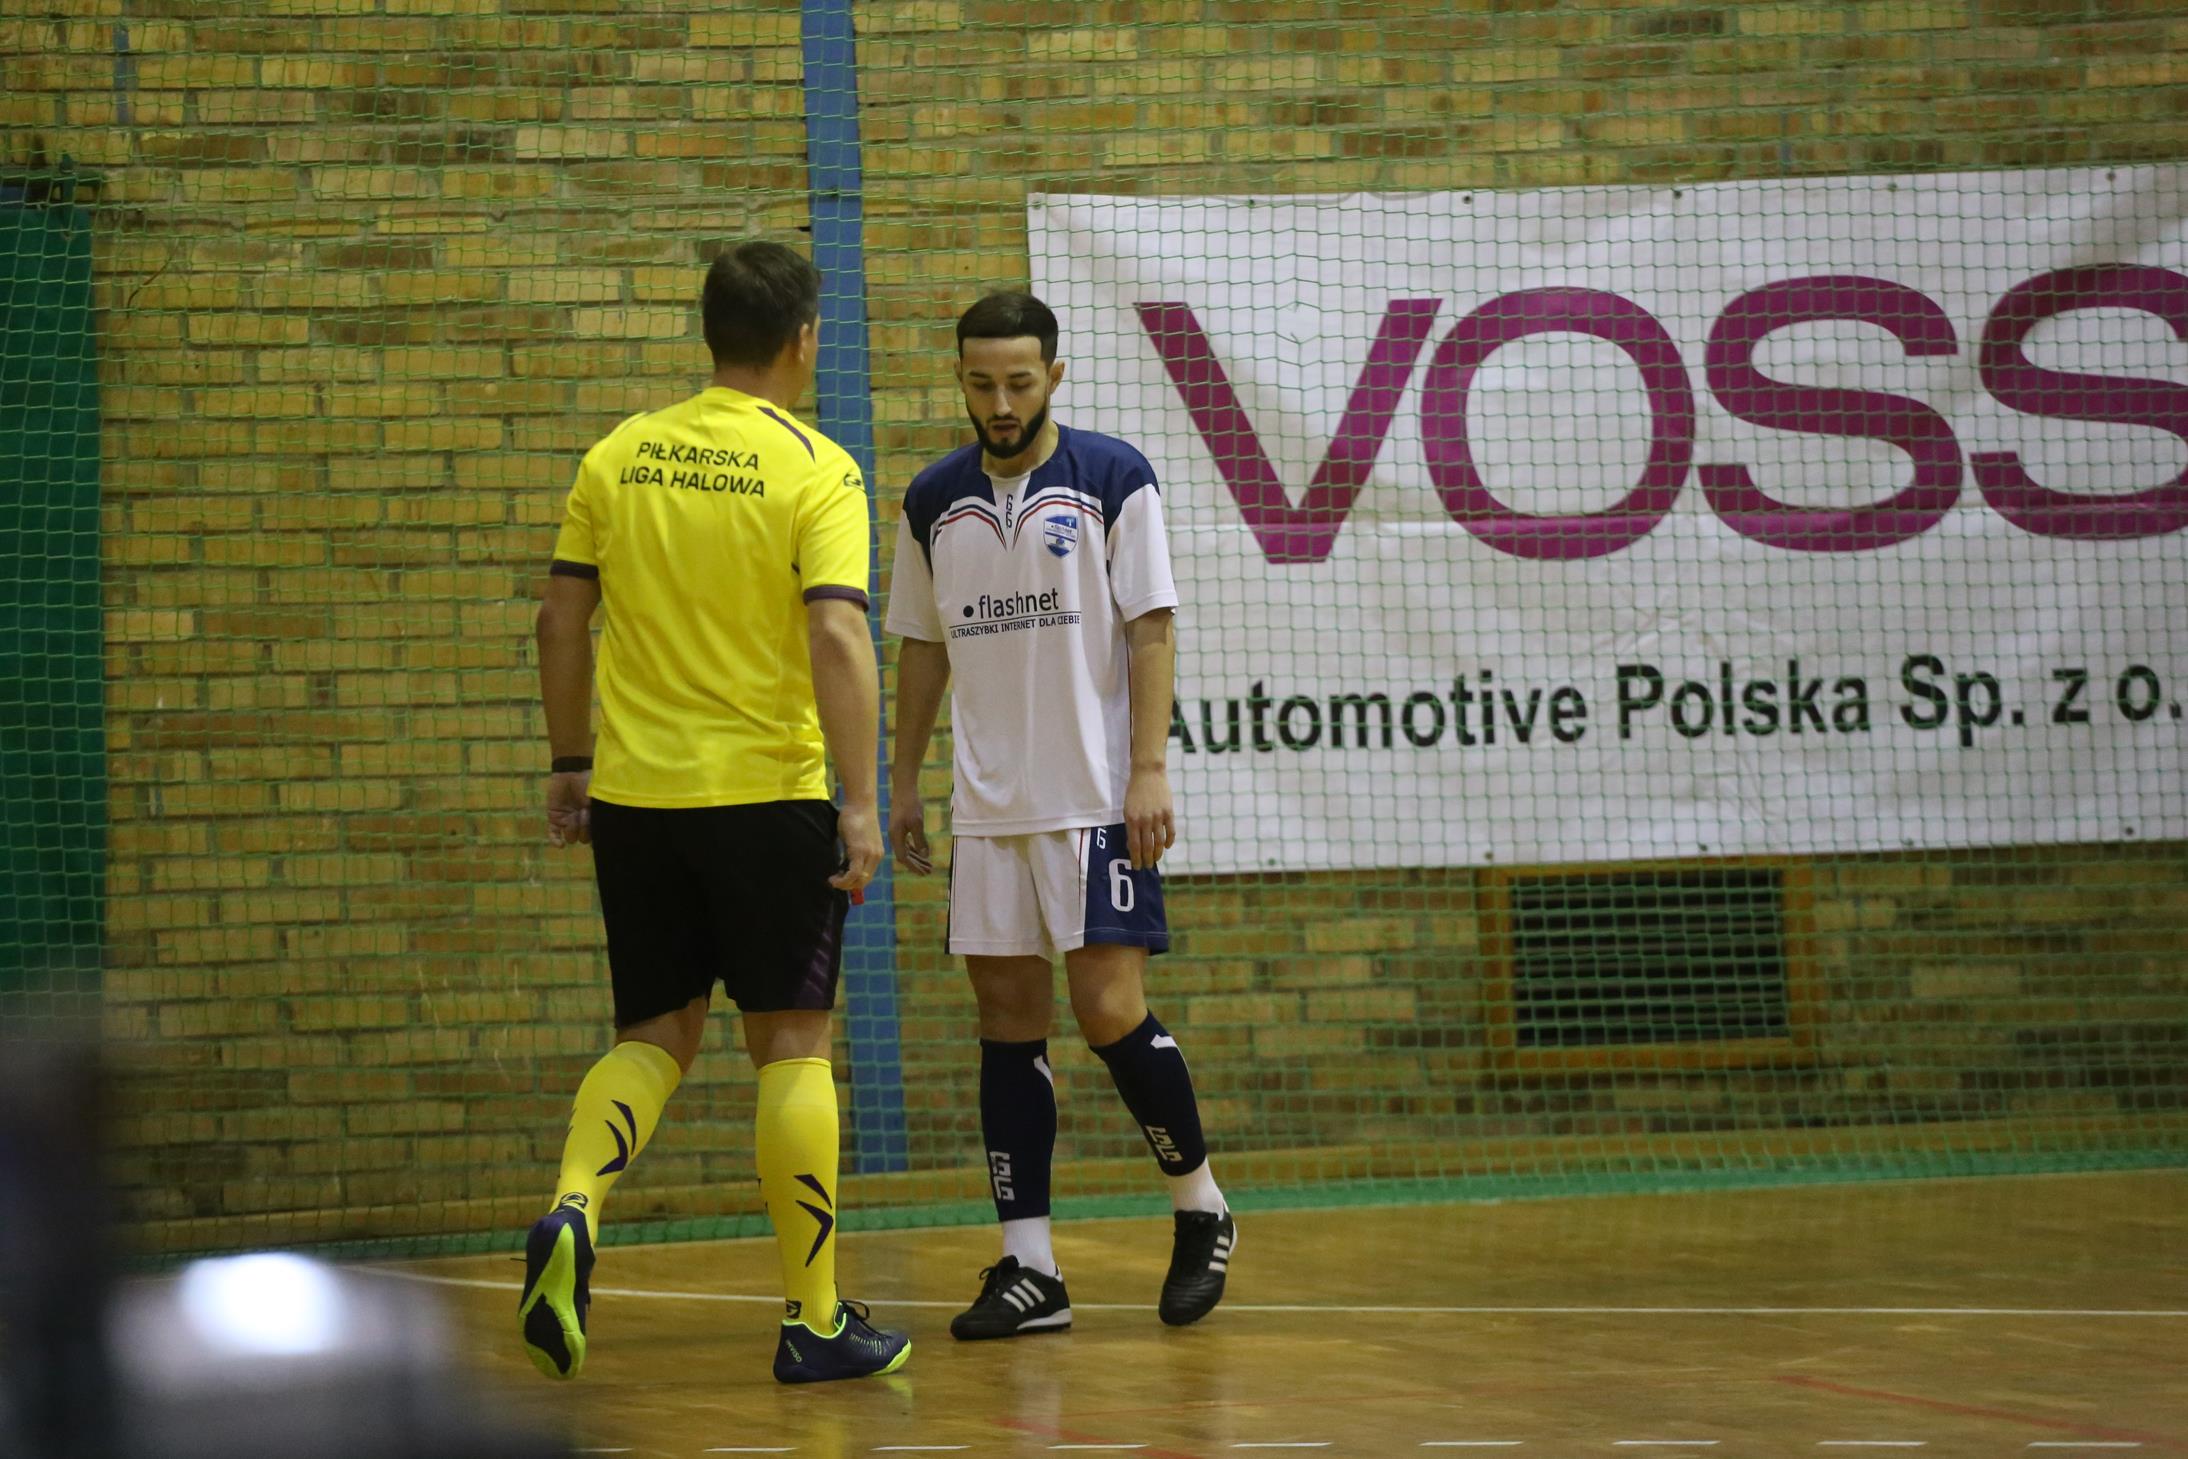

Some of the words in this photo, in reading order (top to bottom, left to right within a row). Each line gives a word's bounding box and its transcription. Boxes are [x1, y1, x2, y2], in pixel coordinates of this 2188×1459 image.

[1133, 263, 2188, 564] VOSS
[636, 441, 760, 471] PIŁKARSKA
[620, 465, 664, 488] LIGA
[670, 470, 766, 498] HALOWA
[978, 587, 1059, 619] flashnet
[1001, 619, 1037, 633] INTERNET
[1039, 616, 1057, 628] DLA
[1167, 668, 1588, 755] Automotive
[1616, 660, 1872, 741] Polska
[1898, 653, 2025, 748] Sp.
[2050, 667, 2092, 726] z
[2116, 664, 2183, 723] o.
[1108, 858, 1135, 913] 6
